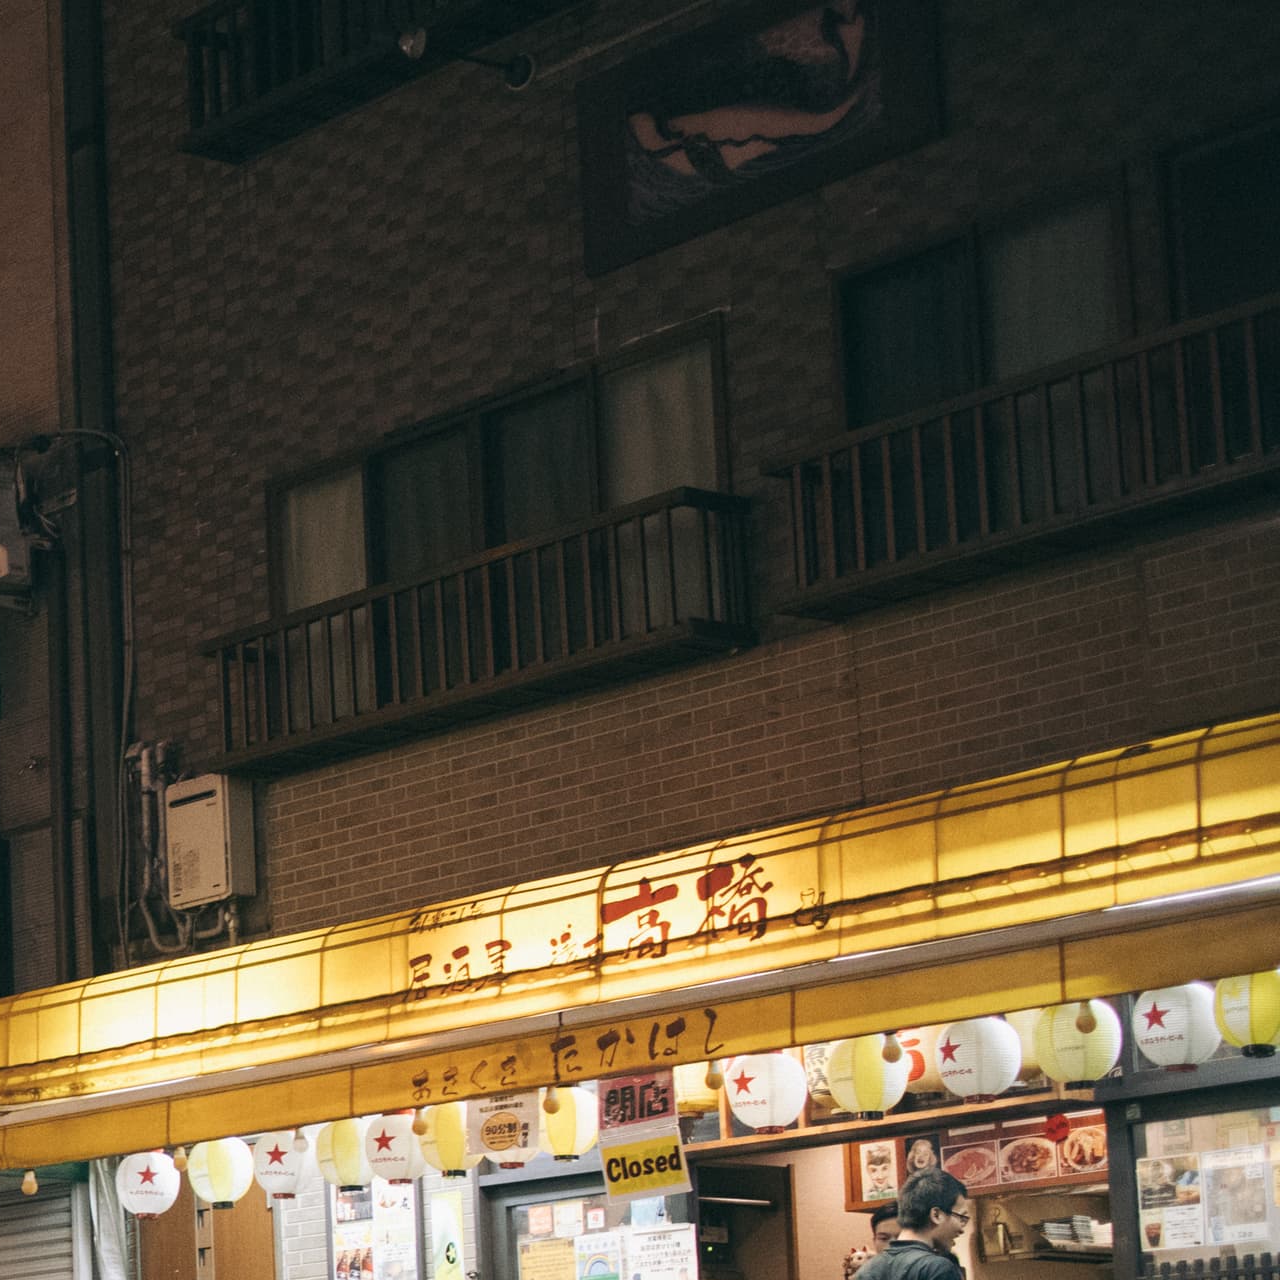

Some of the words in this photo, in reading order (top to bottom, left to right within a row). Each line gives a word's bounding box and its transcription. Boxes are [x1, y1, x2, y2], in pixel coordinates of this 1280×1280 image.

[411, 1054, 518, 1099] あさくさ
[550, 1008, 724, 1082] たかはし
[606, 1145, 682, 1183] Closed
